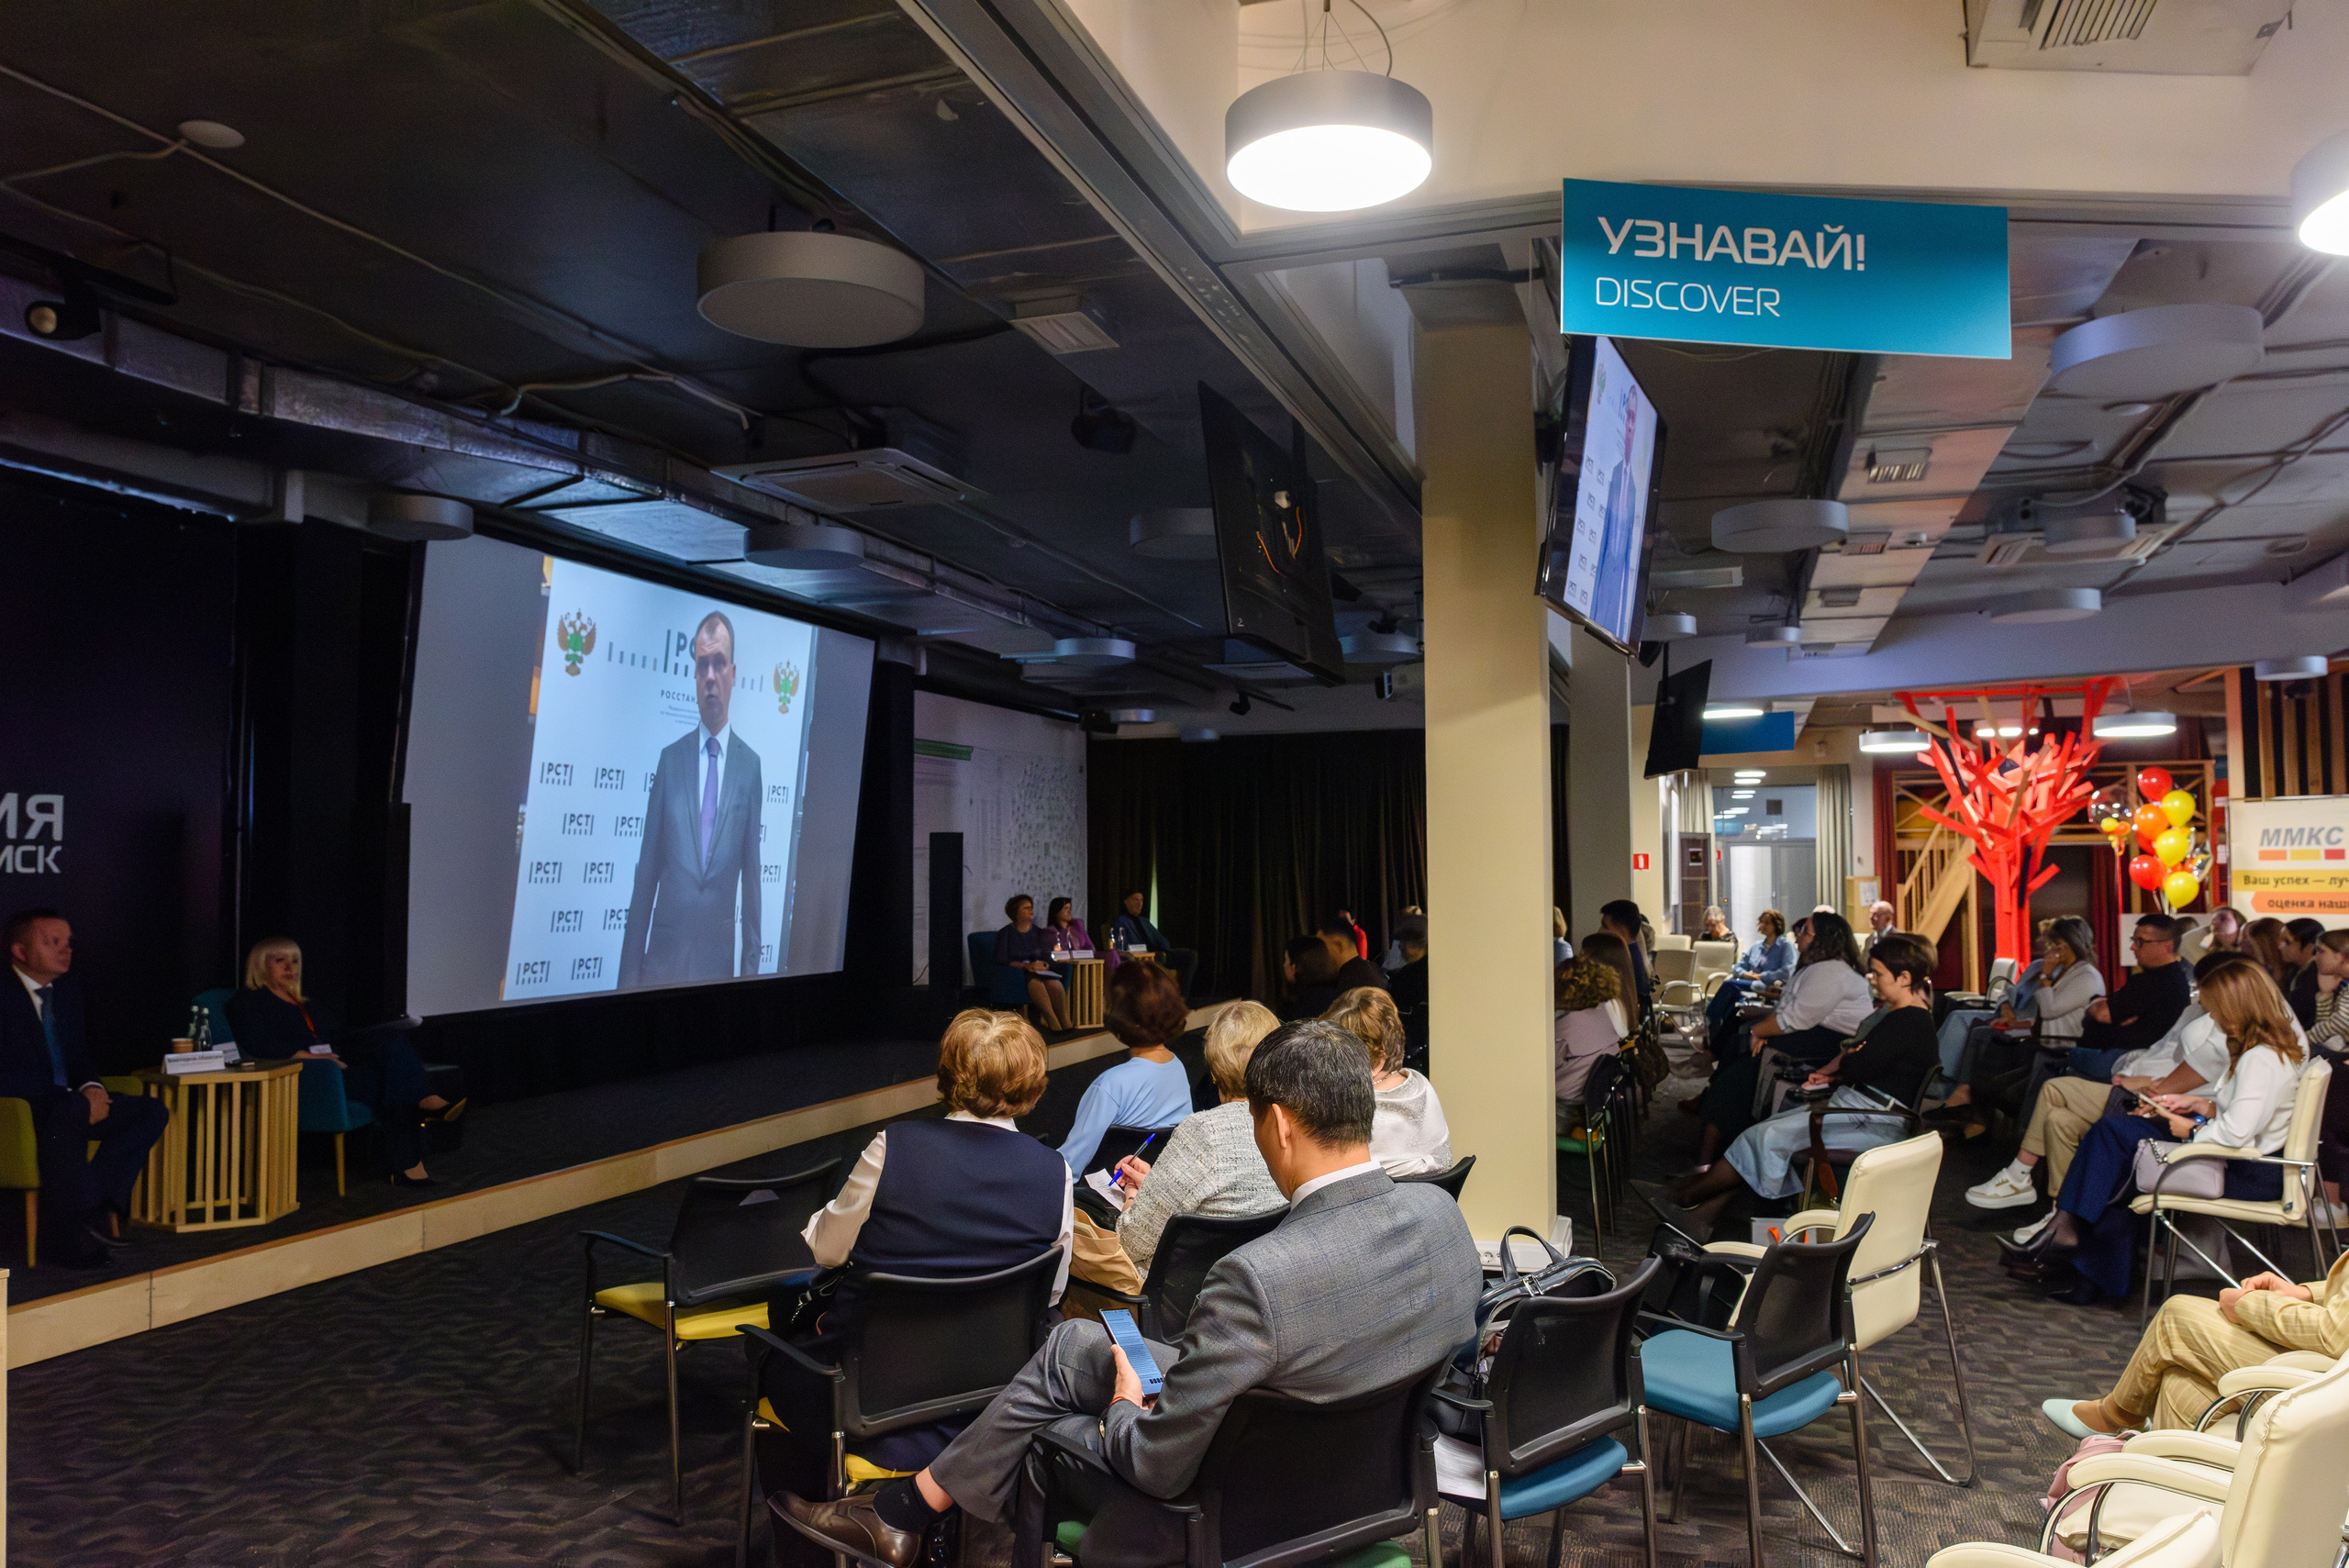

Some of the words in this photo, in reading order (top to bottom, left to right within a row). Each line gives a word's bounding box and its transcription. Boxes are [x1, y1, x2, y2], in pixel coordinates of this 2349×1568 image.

[1598, 216, 1865, 272] УЗНАВАЙ!
[1596, 276, 1780, 317] DISCOVER
[2259, 827, 2343, 847] ММКС
[2243, 875, 2269, 884] Ваш
[2273, 876, 2310, 888] успех
[2267, 899, 2314, 909] оценка
